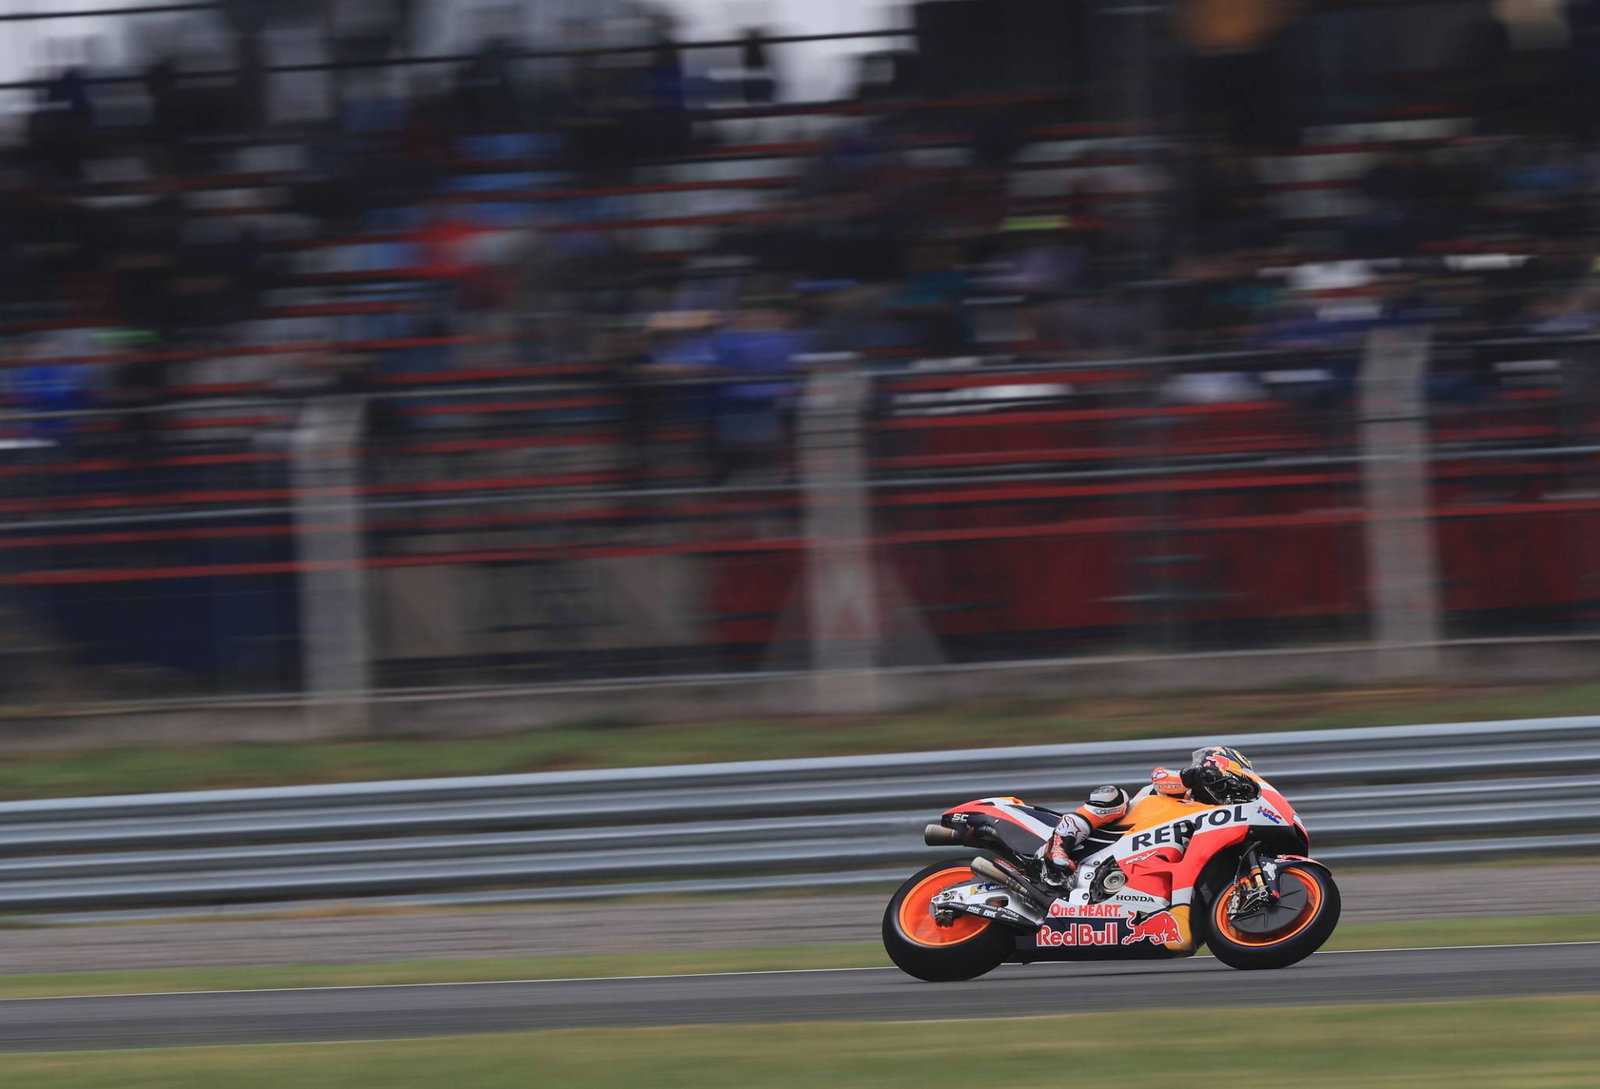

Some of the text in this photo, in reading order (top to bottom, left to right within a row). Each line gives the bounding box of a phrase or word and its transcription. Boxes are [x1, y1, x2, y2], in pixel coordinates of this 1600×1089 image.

[951, 813, 969, 822] SC
[1132, 805, 1247, 851] REPSOL
[1115, 894, 1155, 903] HONDA
[1050, 903, 1075, 917] One
